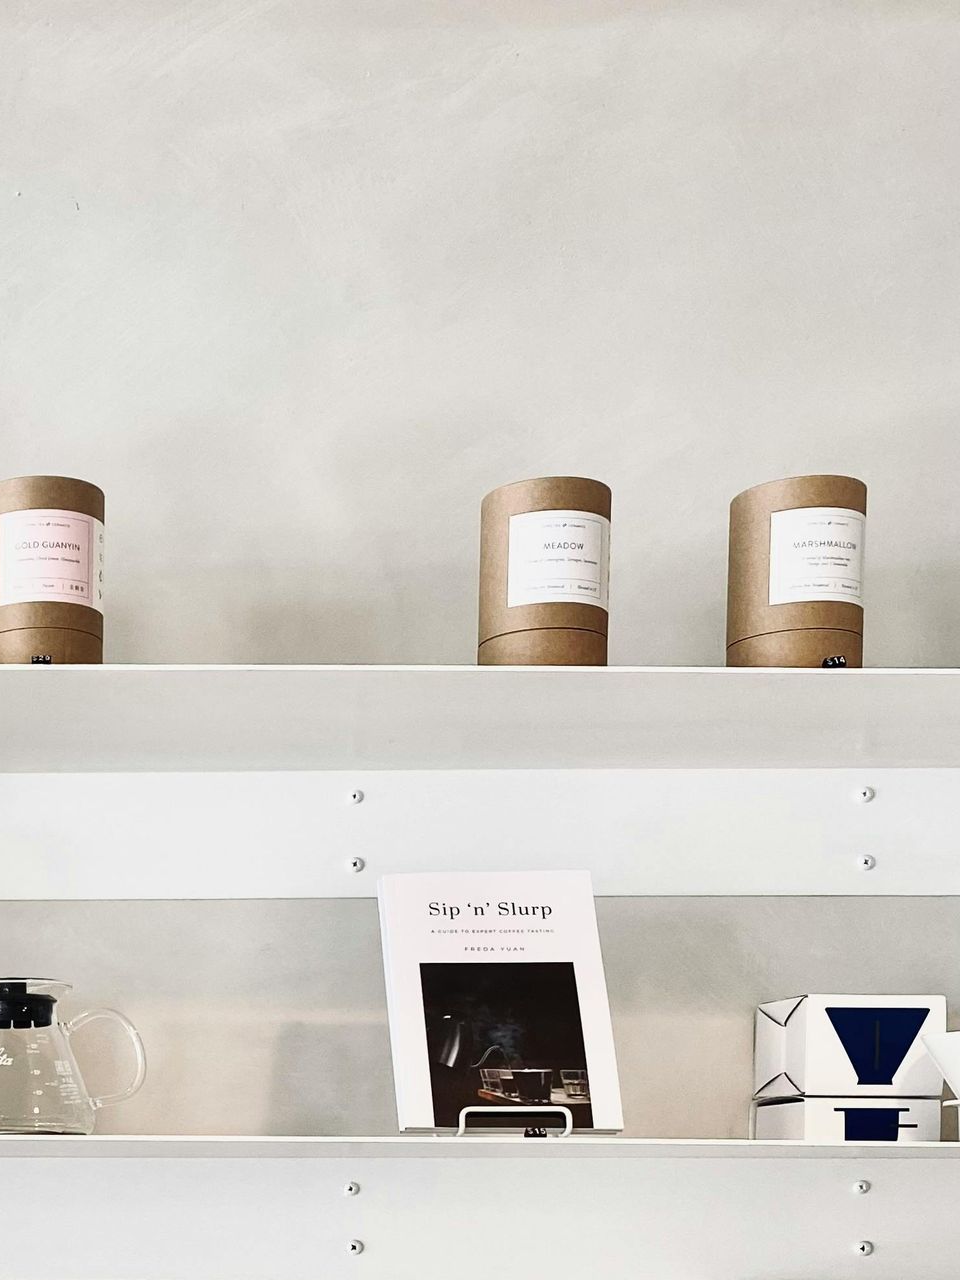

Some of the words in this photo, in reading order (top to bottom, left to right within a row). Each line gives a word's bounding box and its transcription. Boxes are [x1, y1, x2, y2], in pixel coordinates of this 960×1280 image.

[41, 540, 81, 552] GUANYIN
[543, 542, 584, 550] MEADOW
[792, 540, 857, 550] MARSHMALLOW
[428, 901, 461, 920] Sip
[497, 901, 553, 920] Slurp
